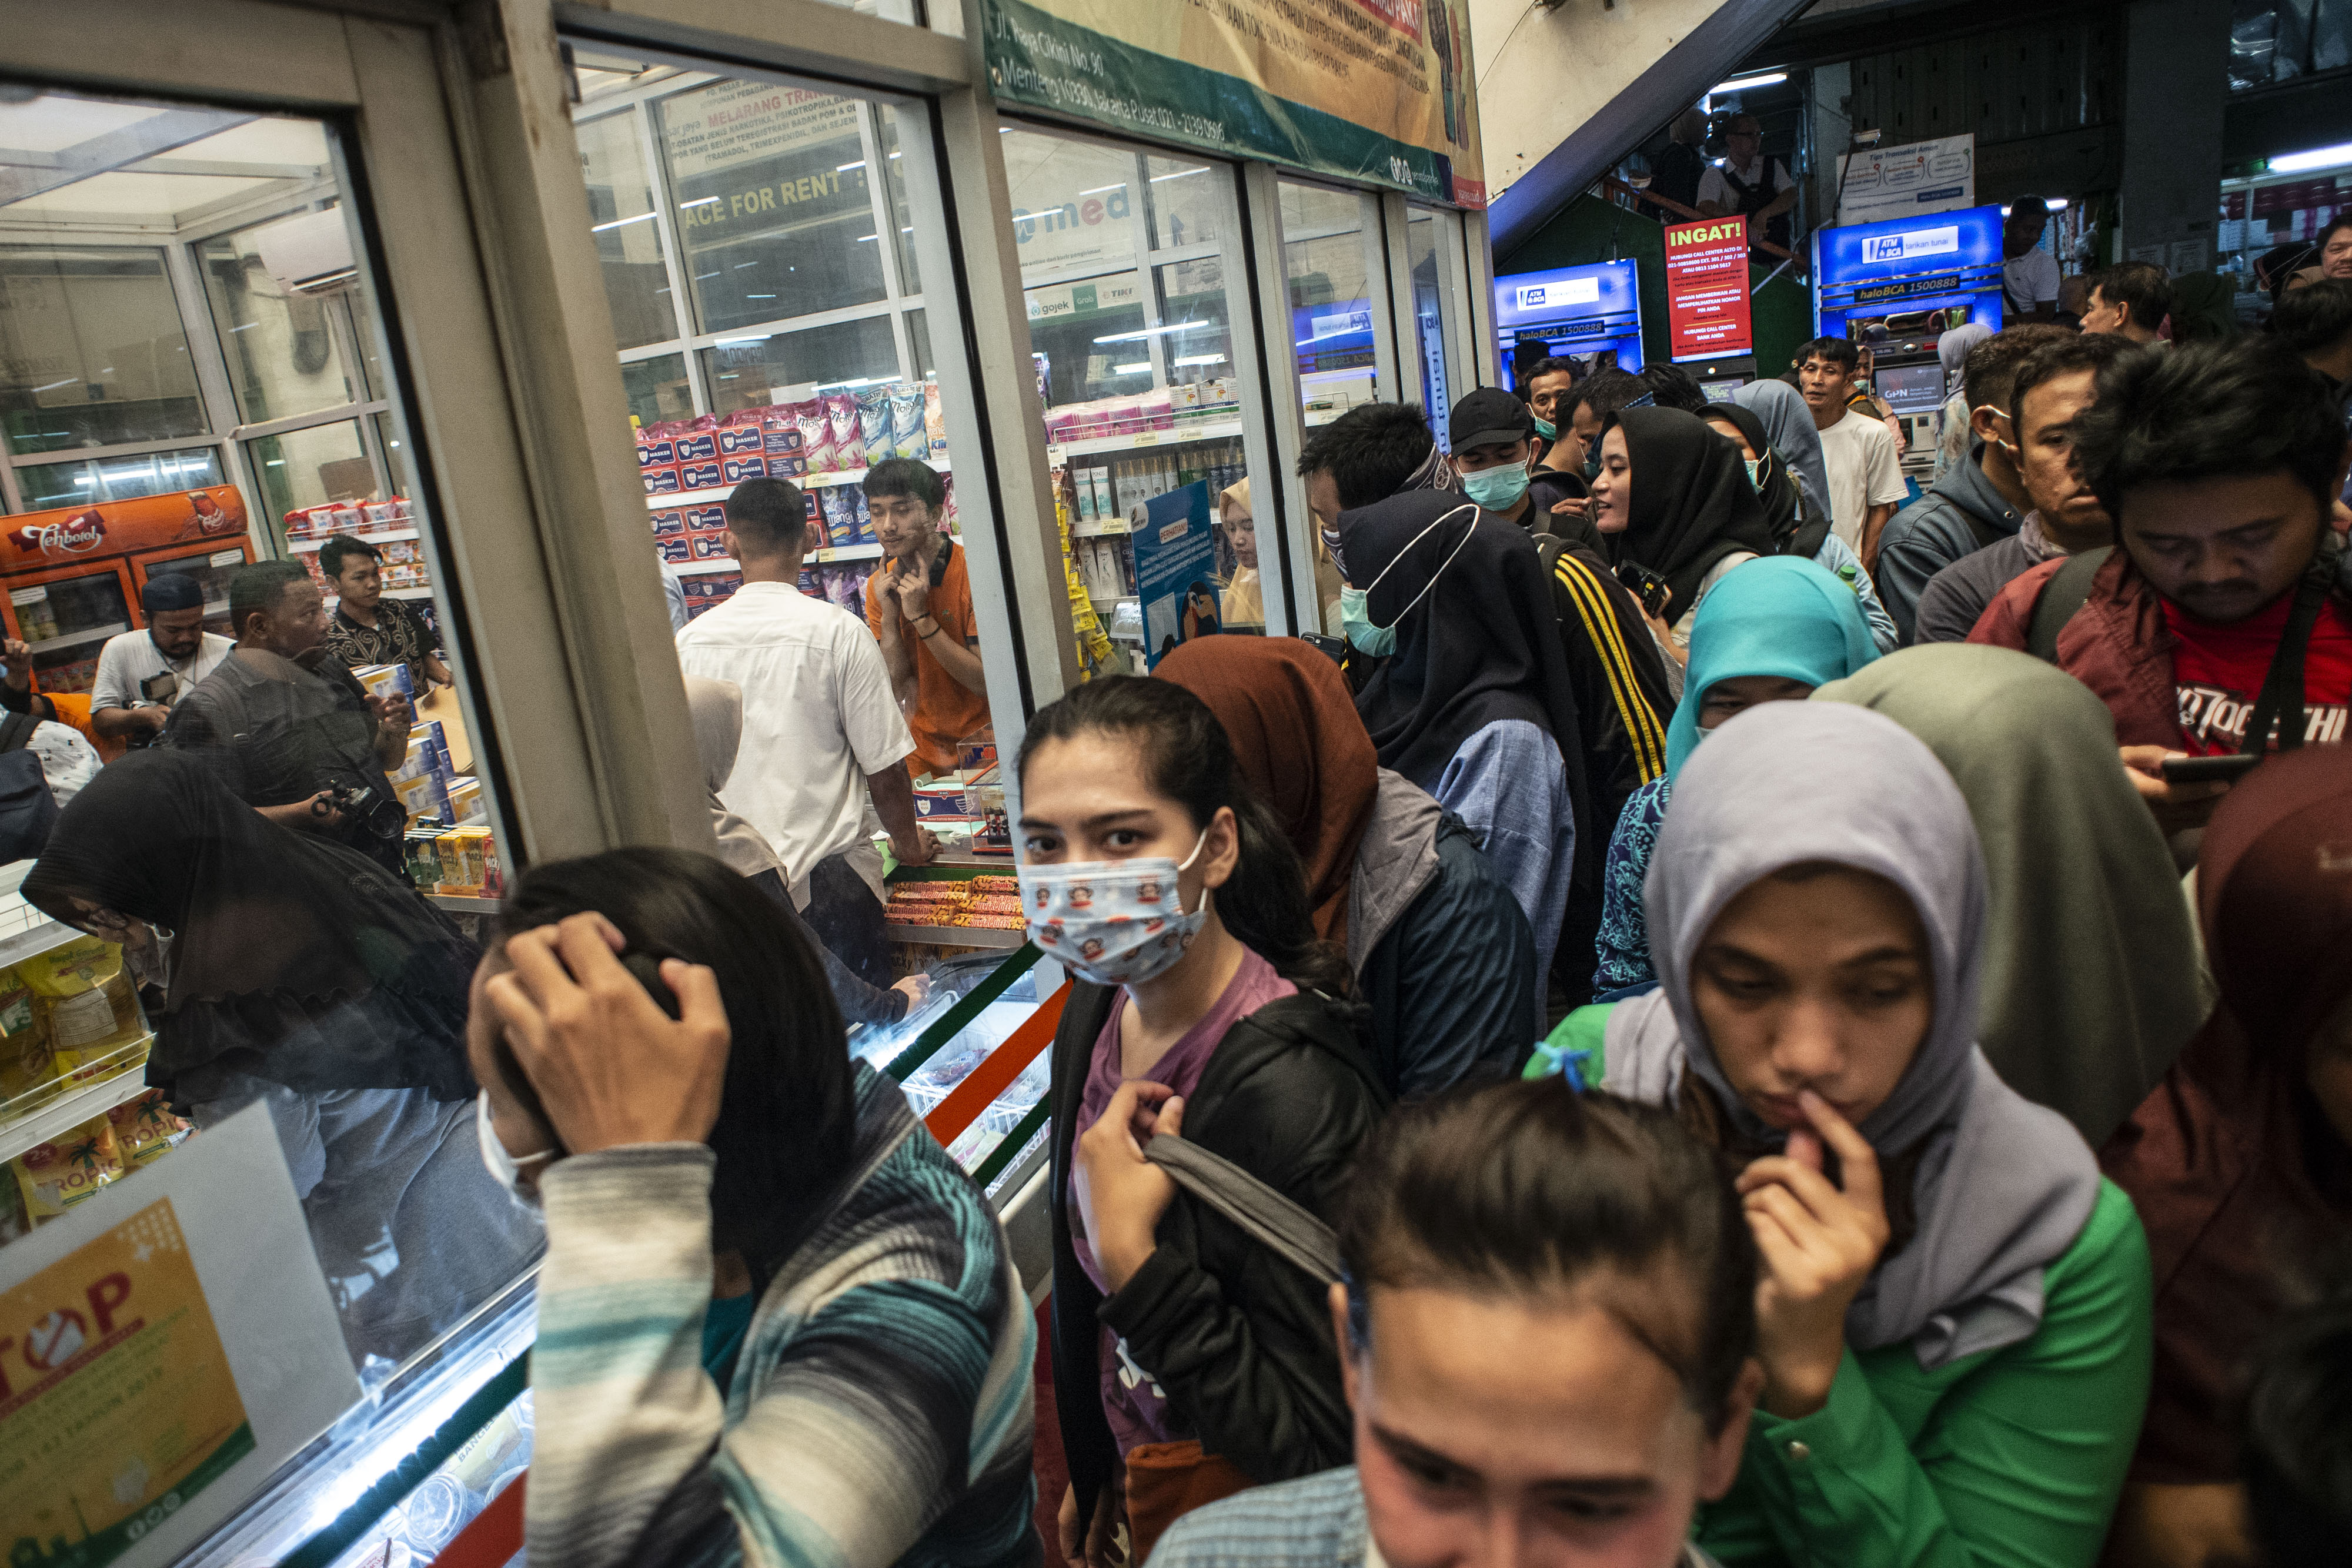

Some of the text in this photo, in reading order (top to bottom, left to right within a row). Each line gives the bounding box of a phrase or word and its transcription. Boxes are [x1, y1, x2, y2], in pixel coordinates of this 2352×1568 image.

[995, 11, 1010, 41] Jl.
[1037, 31, 1069, 64] Cikini
[1070, 42, 1090, 73] No.
[1090, 52, 1104, 78] 90
[1001, 56, 1060, 105] Menteng
[1093, 91, 1131, 121] Jakarta
[1131, 99, 1157, 126] Pusat
[708, 95, 781, 127] MELARANG
[791, 116, 817, 128] BADAN
[819, 109, 836, 121] POM
[811, 122, 827, 135] DAN
[1869, 153, 1883, 161] Tips
[1885, 148, 1917, 159] Transaksi
[685, 199, 726, 229] ACE
[730, 186, 777, 218] FOR
[780, 170, 841, 206] RENT
[1044, 185, 1130, 234] med
[1670, 222, 1741, 247] INGAT!
[1882, 239, 1897, 248] ATM
[1906, 239, 1948, 250] tarikan tunai
[1670, 253, 1693, 261] HUBUNGI
[1886, 248, 1901, 257] BCA
[1029, 258, 1045, 267] online
[1046, 255, 1057, 263] dan
[1111, 288, 1132, 297] TIKI
[1696, 290, 1728, 299] MEMBERIKAN
[1860, 277, 1957, 299] haloBCA 1500888
[1042, 300, 1069, 315] gojek
[1678, 298, 1721, 309] MEMPERLIHATKAN
[1520, 323, 1602, 340] haloBCA 1500888
[1885, 389, 1908, 398] GPN
[974, 902, 1015, 911] SILVERQUEEN
[970, 918, 1011, 928] SILVERQUEEN
[32, 1147, 51, 1161] 2x
